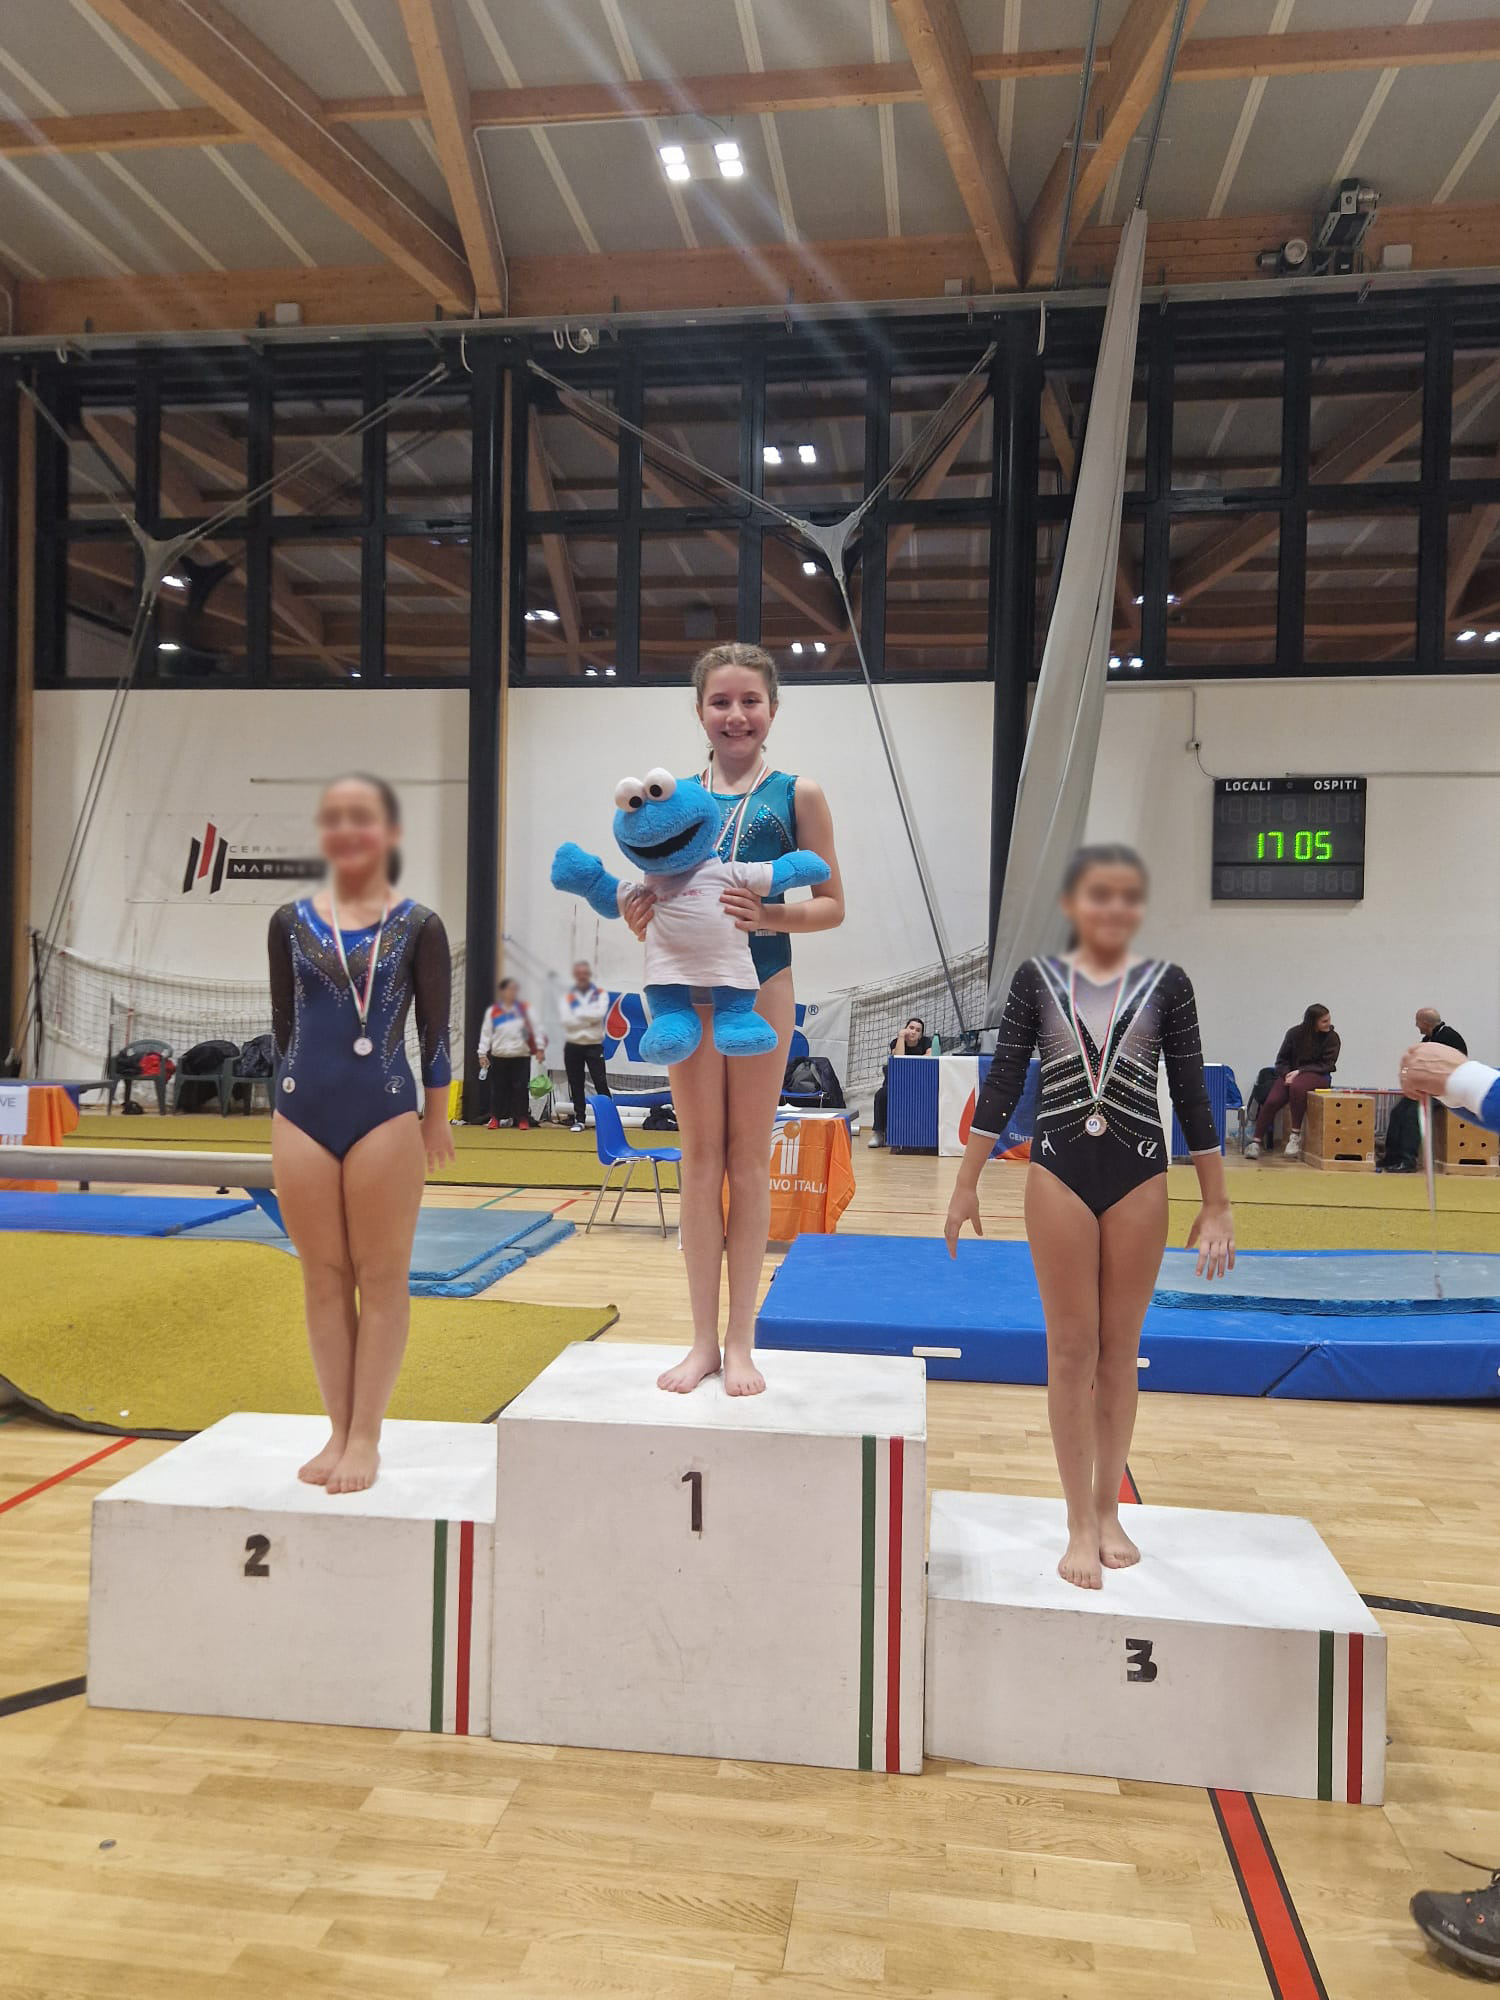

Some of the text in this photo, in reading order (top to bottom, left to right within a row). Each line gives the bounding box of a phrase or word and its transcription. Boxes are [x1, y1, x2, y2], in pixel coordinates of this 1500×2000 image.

[1225, 780, 1357, 791] LOCALI OSPITI
[681, 1471, 702, 1532] 1
[244, 1534, 270, 1576] 2
[1125, 1638, 1158, 1682] 3
